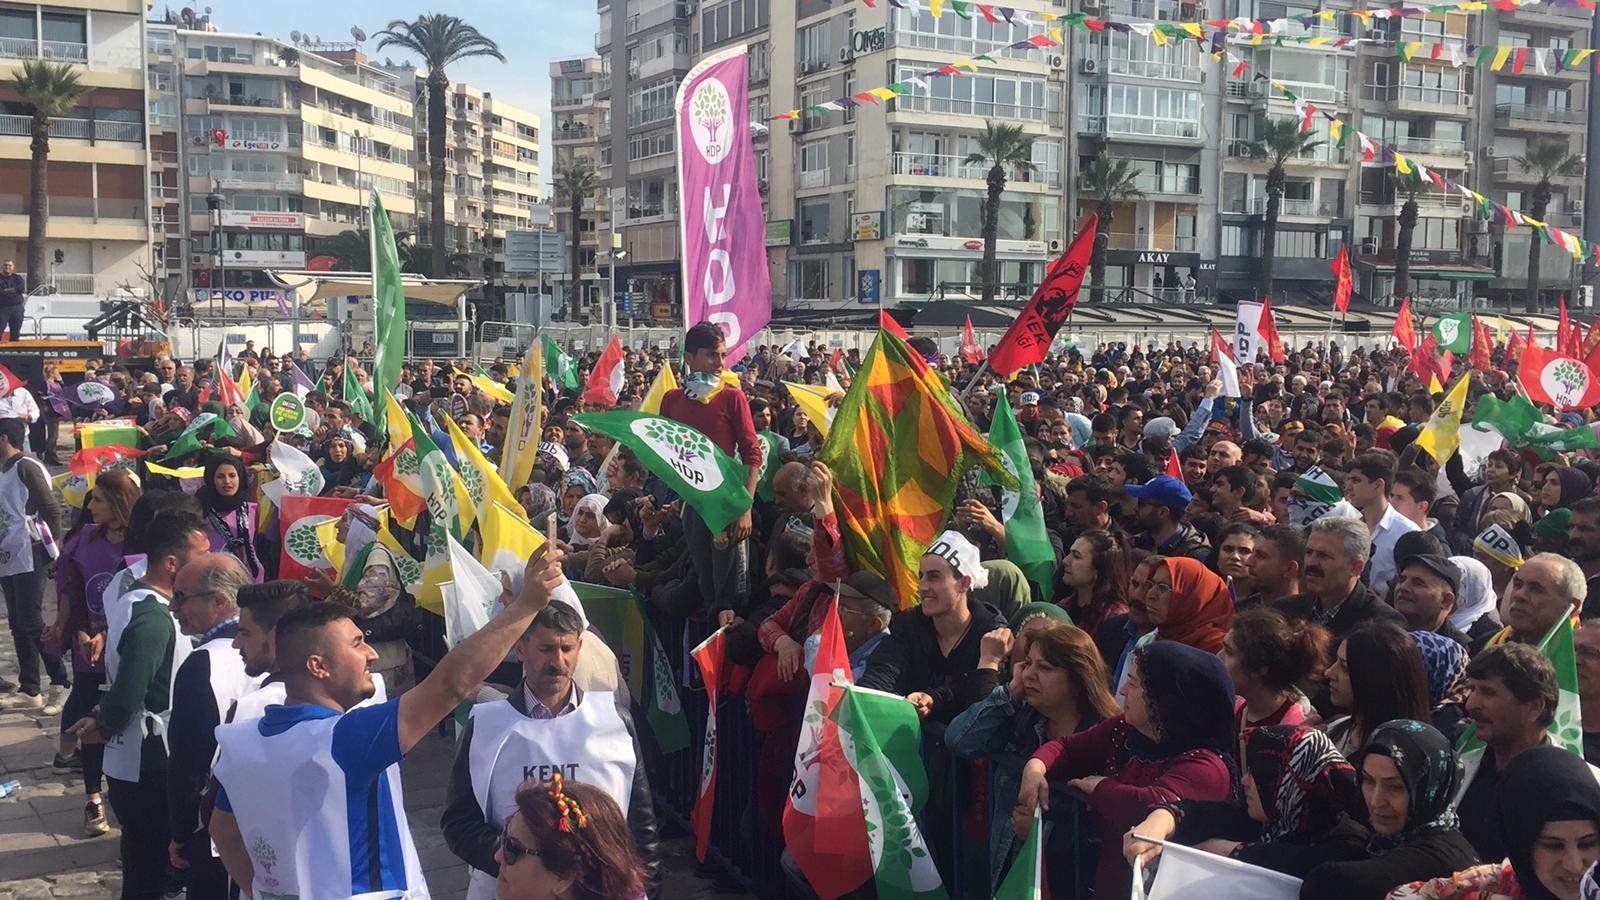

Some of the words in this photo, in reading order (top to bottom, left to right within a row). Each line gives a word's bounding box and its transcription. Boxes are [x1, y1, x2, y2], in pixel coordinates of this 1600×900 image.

[706, 144, 721, 157] HDP
[1138, 252, 1170, 263] AKAY
[1199, 263, 1216, 271] AKAY
[670, 457, 704, 485] HDP
[523, 763, 579, 783] KENT
